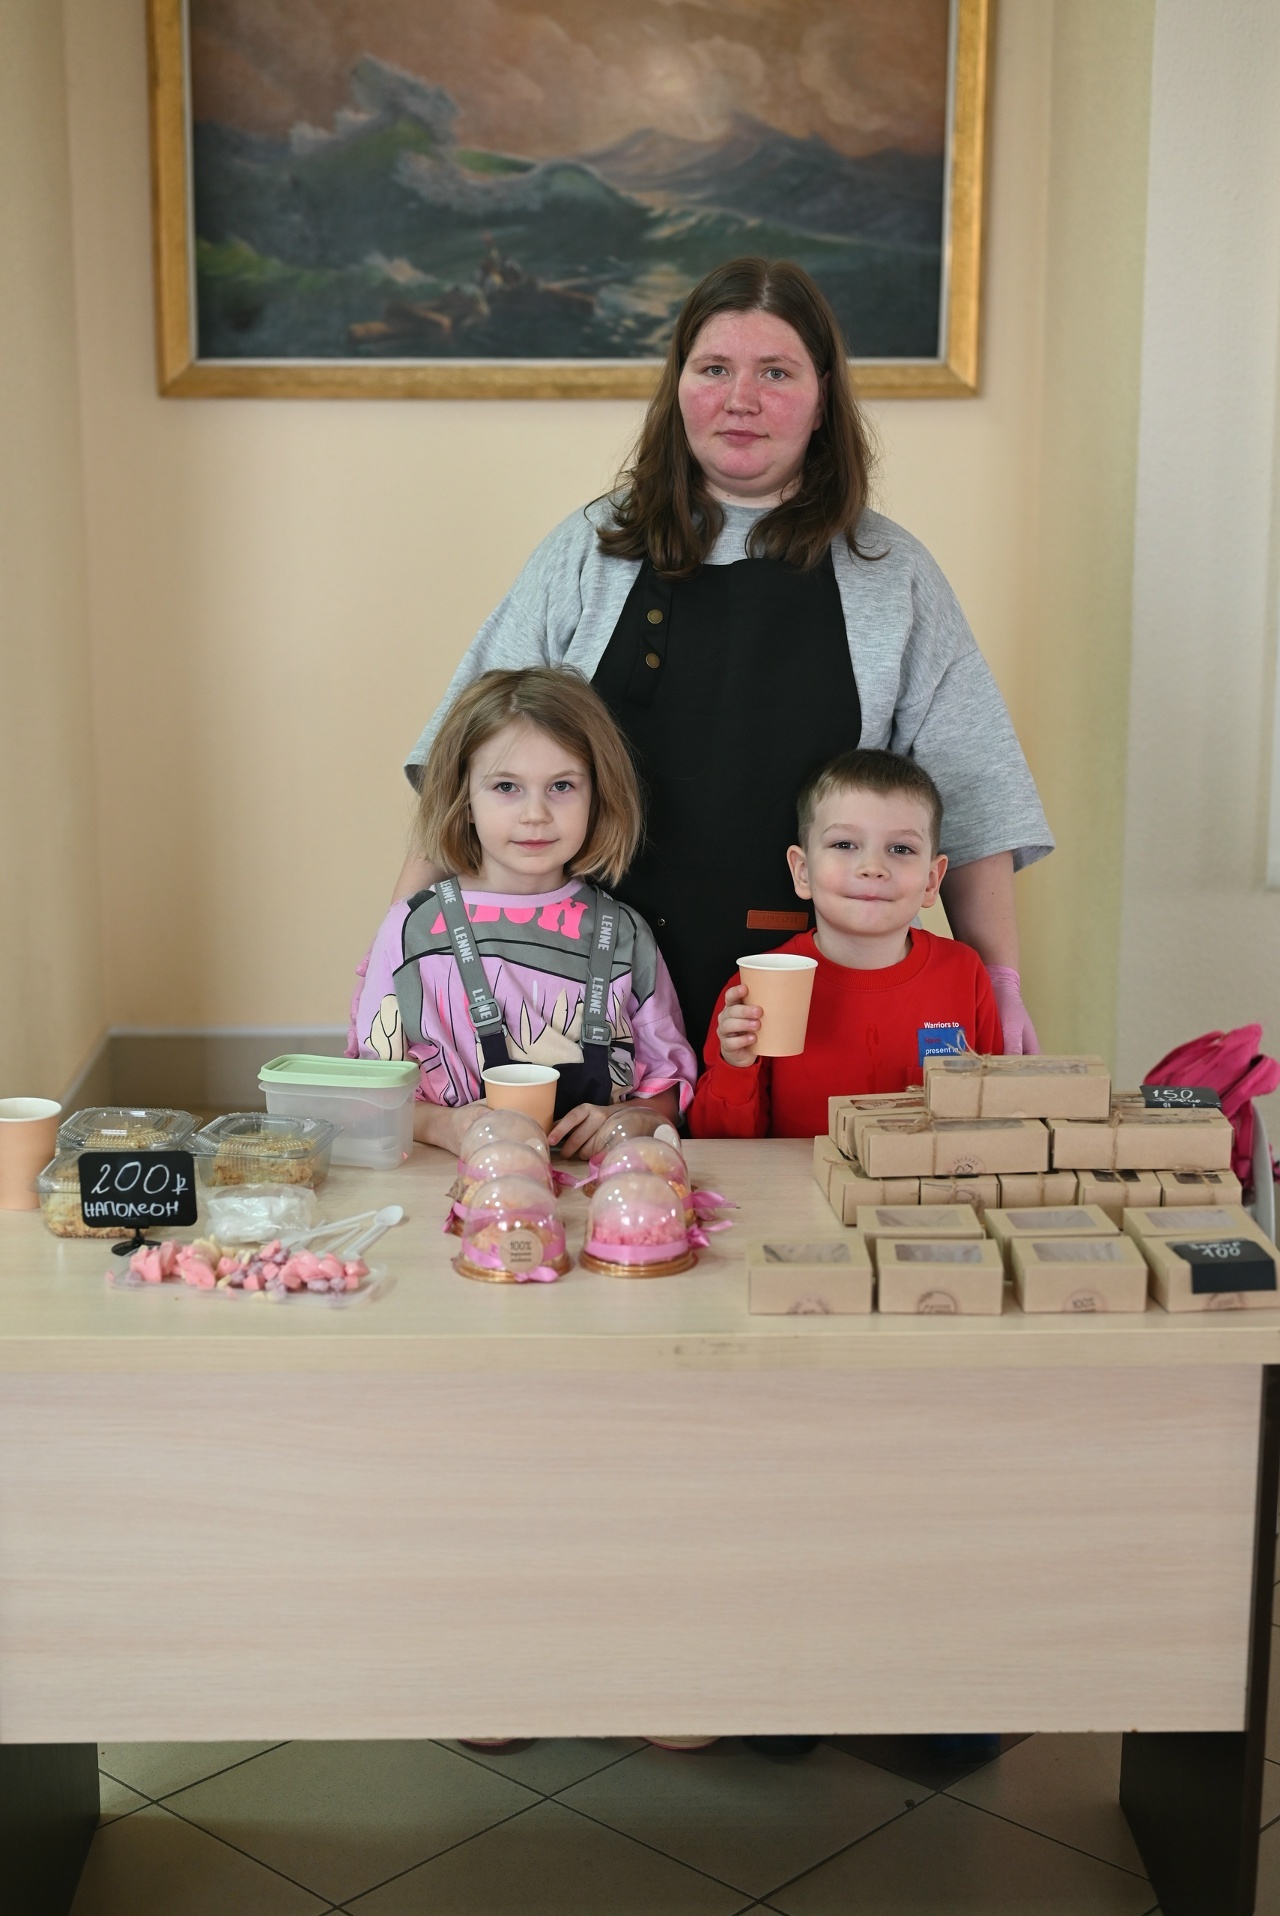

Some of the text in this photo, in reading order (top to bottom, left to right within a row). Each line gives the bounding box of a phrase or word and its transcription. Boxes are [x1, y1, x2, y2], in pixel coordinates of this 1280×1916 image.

[440, 880, 457, 904] LENNE
[598, 914, 614, 951] LENNE
[453, 926, 475, 964] LENNE
[472, 988, 493, 1020] LENE
[589, 976, 604, 1015] LENNE
[924, 1021, 951, 1029] Warriors
[925, 1046, 951, 1056] present
[1152, 1089, 1194, 1100] 150
[1201, 1246, 1242, 1258] 100
